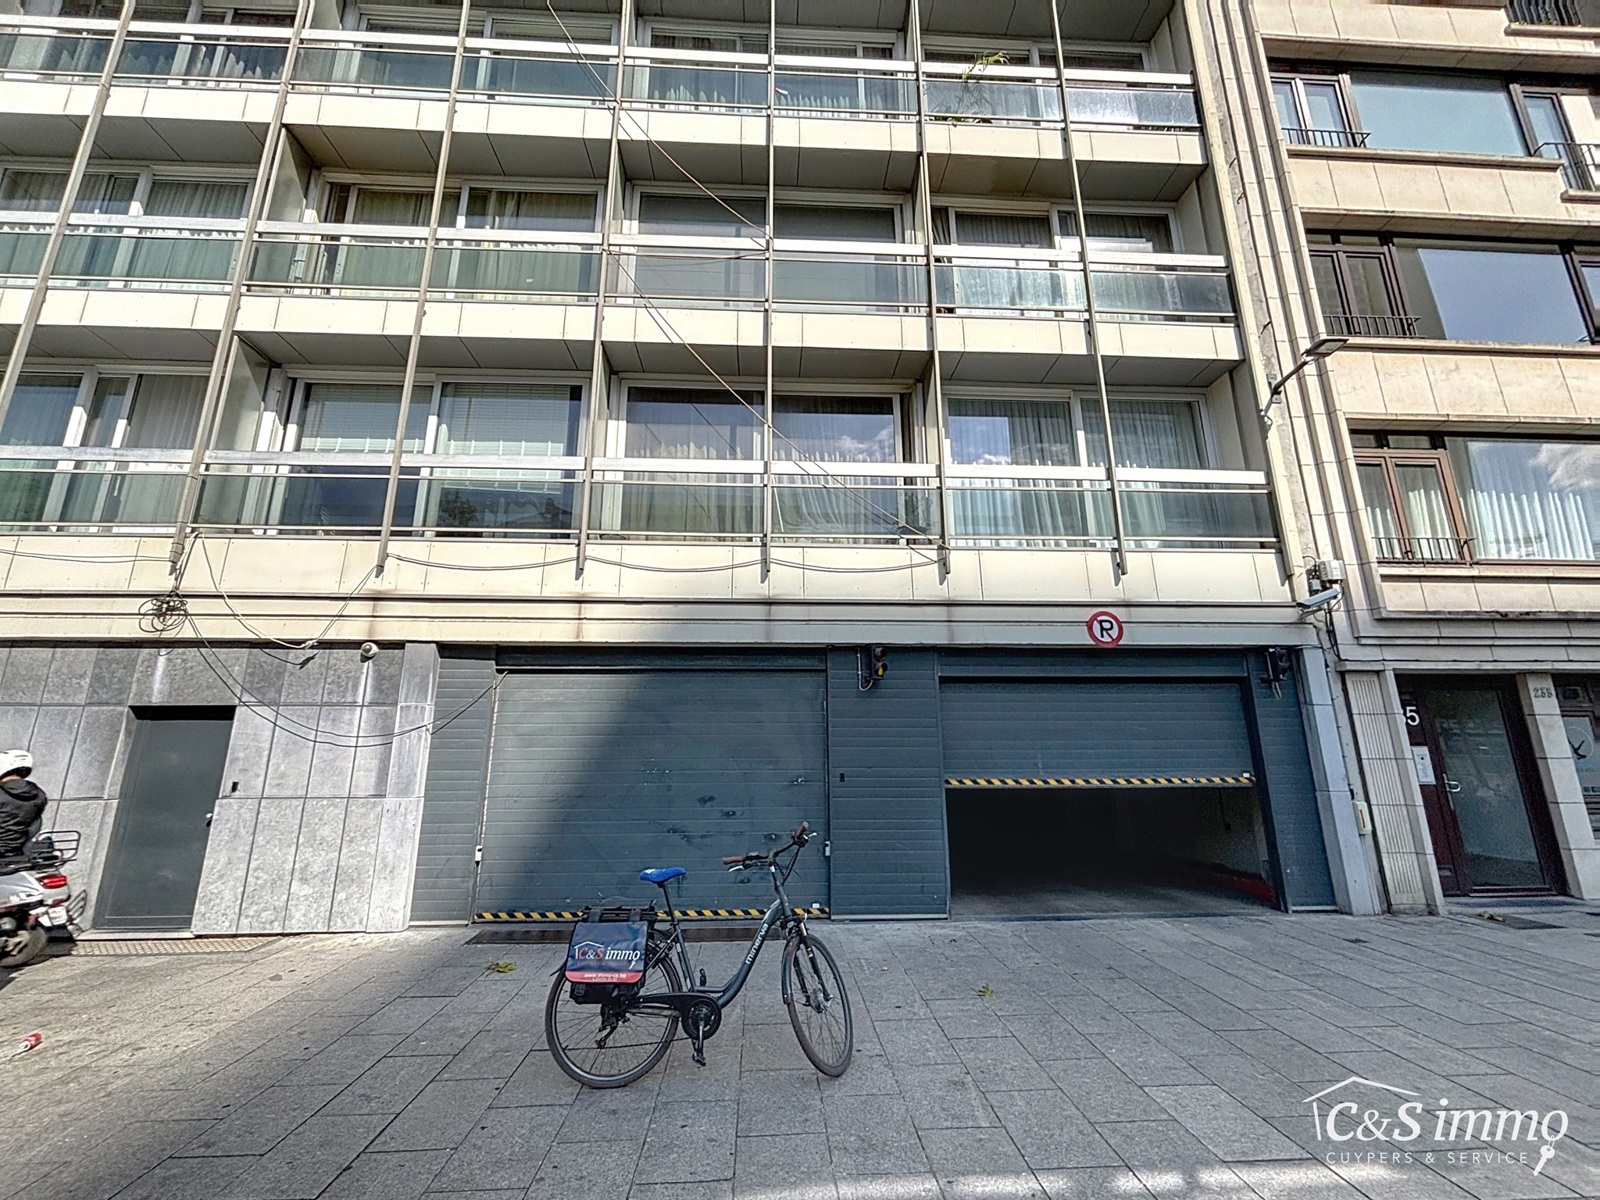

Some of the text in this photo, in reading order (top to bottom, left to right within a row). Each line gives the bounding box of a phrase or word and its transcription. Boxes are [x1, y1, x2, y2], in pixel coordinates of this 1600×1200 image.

[1402, 706, 1420, 726] 5
[579, 946, 641, 961] C&S immo
[745, 923, 769, 964] minerva
